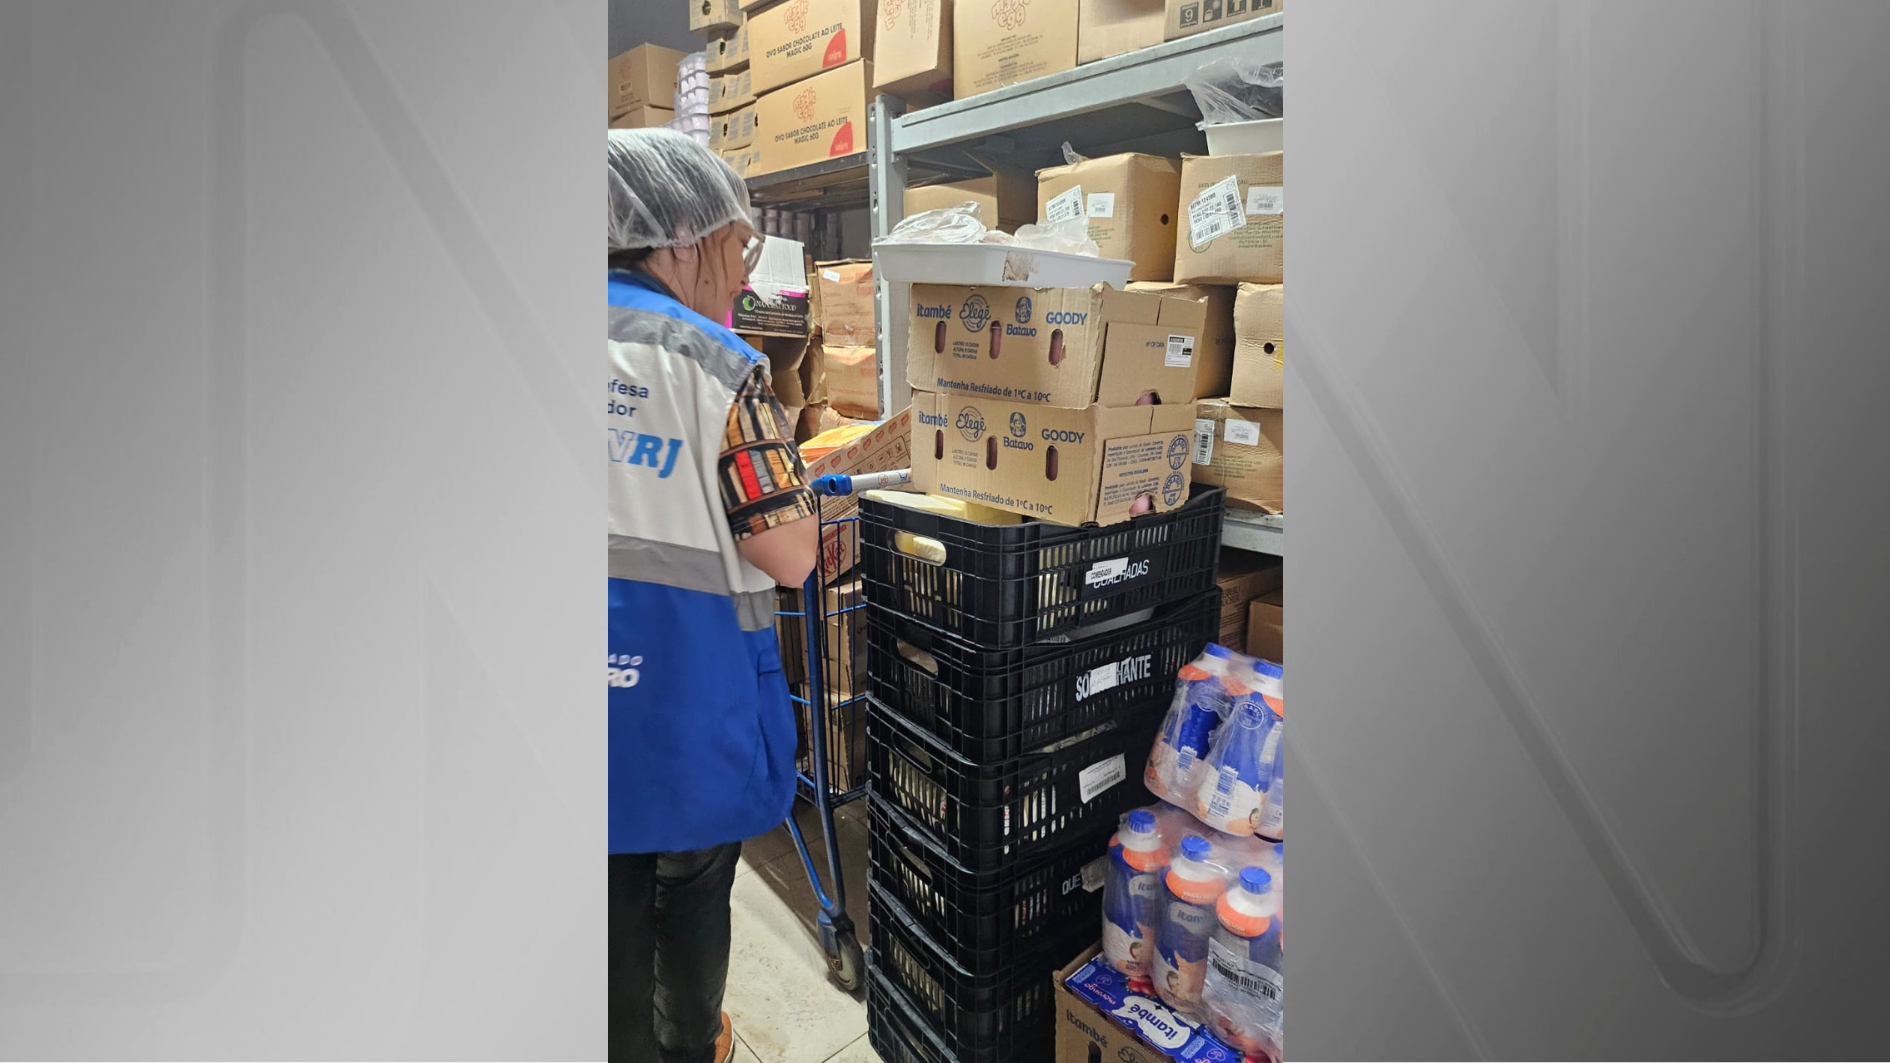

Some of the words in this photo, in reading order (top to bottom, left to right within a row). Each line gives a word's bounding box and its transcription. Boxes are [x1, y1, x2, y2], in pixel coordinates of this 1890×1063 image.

[1185, 8, 1194, 22] 9
[766, 48, 776, 58] OVO
[777, 43, 792, 54] SABOR
[792, 31, 820, 48] CHOCOLATE
[821, 28, 829, 36] AO
[830, 23, 843, 33] LEITE
[786, 47, 802, 58] MAGIC
[785, 130, 800, 140] SABOR
[800, 122, 826, 135] CHOCOLATE
[836, 116, 848, 126] LEITE
[794, 136, 809, 144] MAGIC
[916, 303, 952, 319] itambé
[958, 302, 991, 328] Elegê
[1046, 311, 1088, 326] GOODY
[1006, 324, 1037, 337] Batavo
[937, 378, 969, 391] Mantenha
[970, 382, 1002, 396] Resfriado
[1003, 387, 1012, 397] de
[918, 410, 948, 427] itambé
[955, 412, 987, 438] Elegê
[1003, 436, 1034, 451] Batavo
[1042, 428, 1085, 444] GOODY
[940, 483, 972, 498] Mantenha
[972, 490, 1004, 504] Resfriado
[1005, 497, 1014, 506] de
[1084, 982, 1116, 1005] morango
[1066, 1008, 1108, 1048] itambé
[1128, 1004, 1178, 1040] itambé
